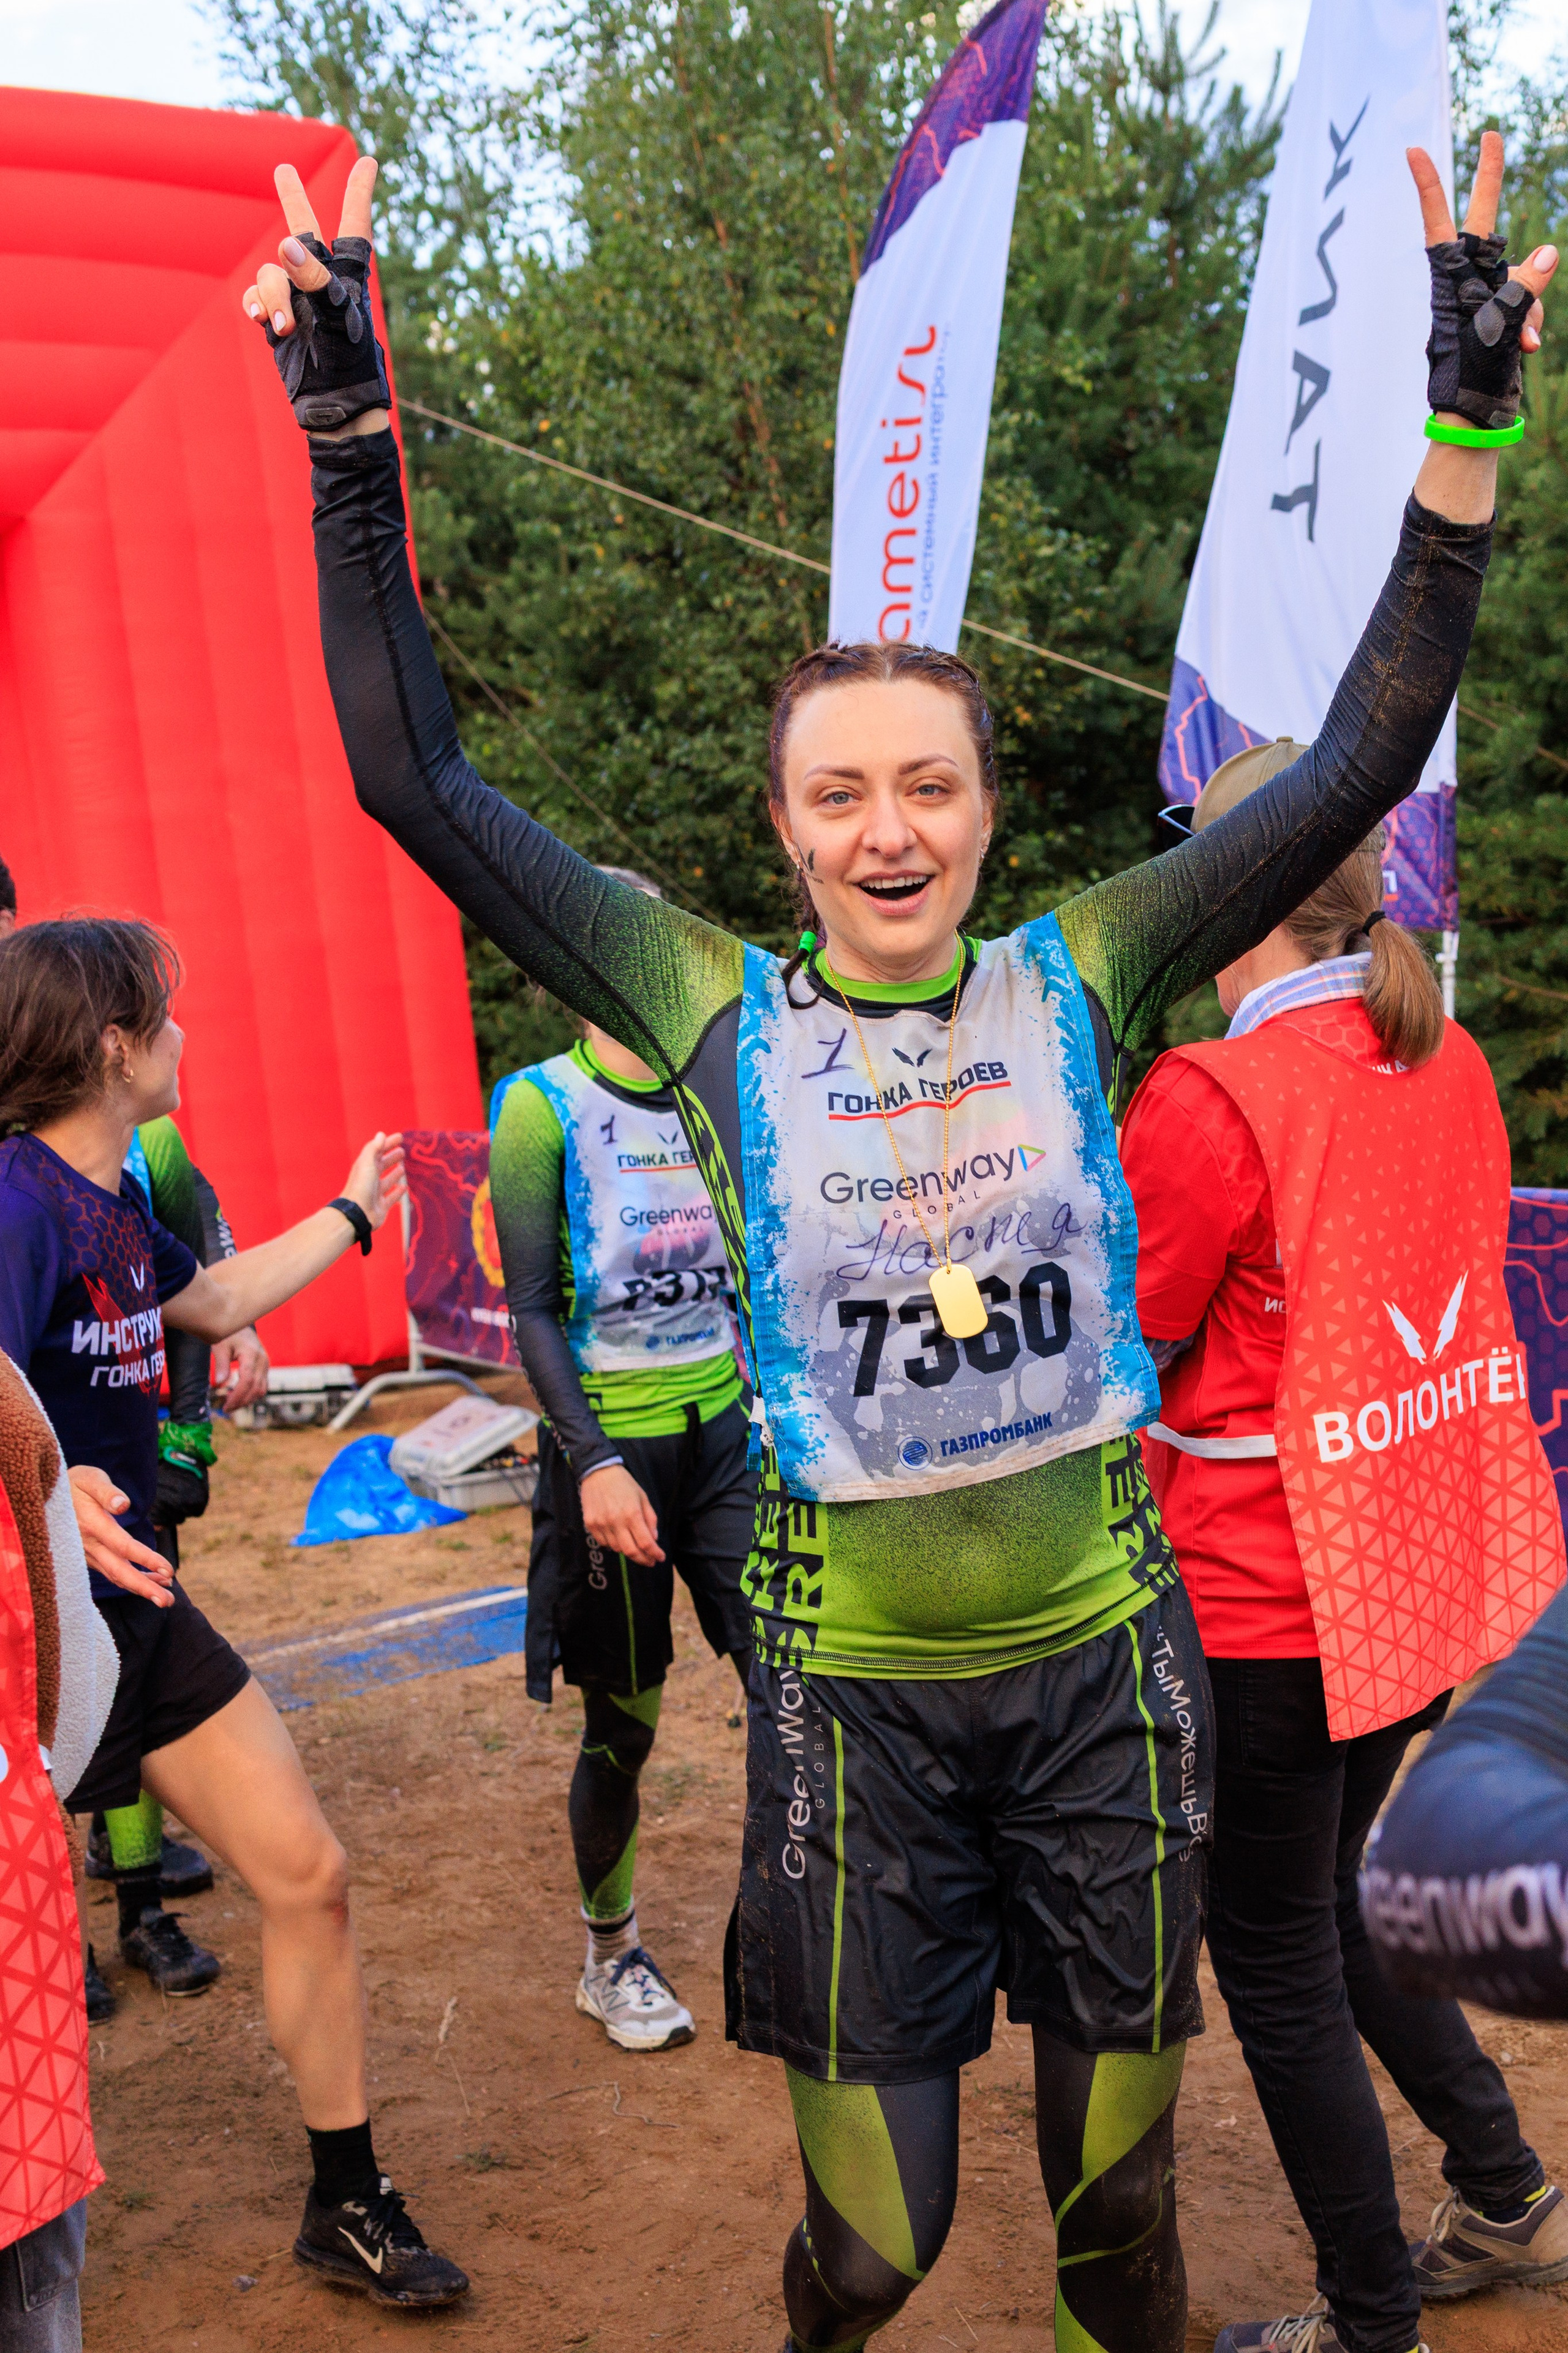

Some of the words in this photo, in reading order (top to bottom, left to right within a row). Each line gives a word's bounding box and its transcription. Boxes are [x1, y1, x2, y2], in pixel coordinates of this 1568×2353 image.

[828, 1082, 912, 1114] ГОНКА
[919, 1061, 1009, 1101] ГЕРОЕВ
[617, 1153, 669, 1169] ГОНКА
[820, 1151, 1017, 1203] Greenway
[620, 1204, 717, 1226] Greenwa
[892, 1191, 981, 1221] GLOBAL
[837, 1262, 1072, 1398] 7360
[90, 1358, 150, 1388] ГОНКА
[940, 1410, 1054, 1457] ГАЗПРОМБАНК
[812, 1706, 826, 1809] GLOBAL
